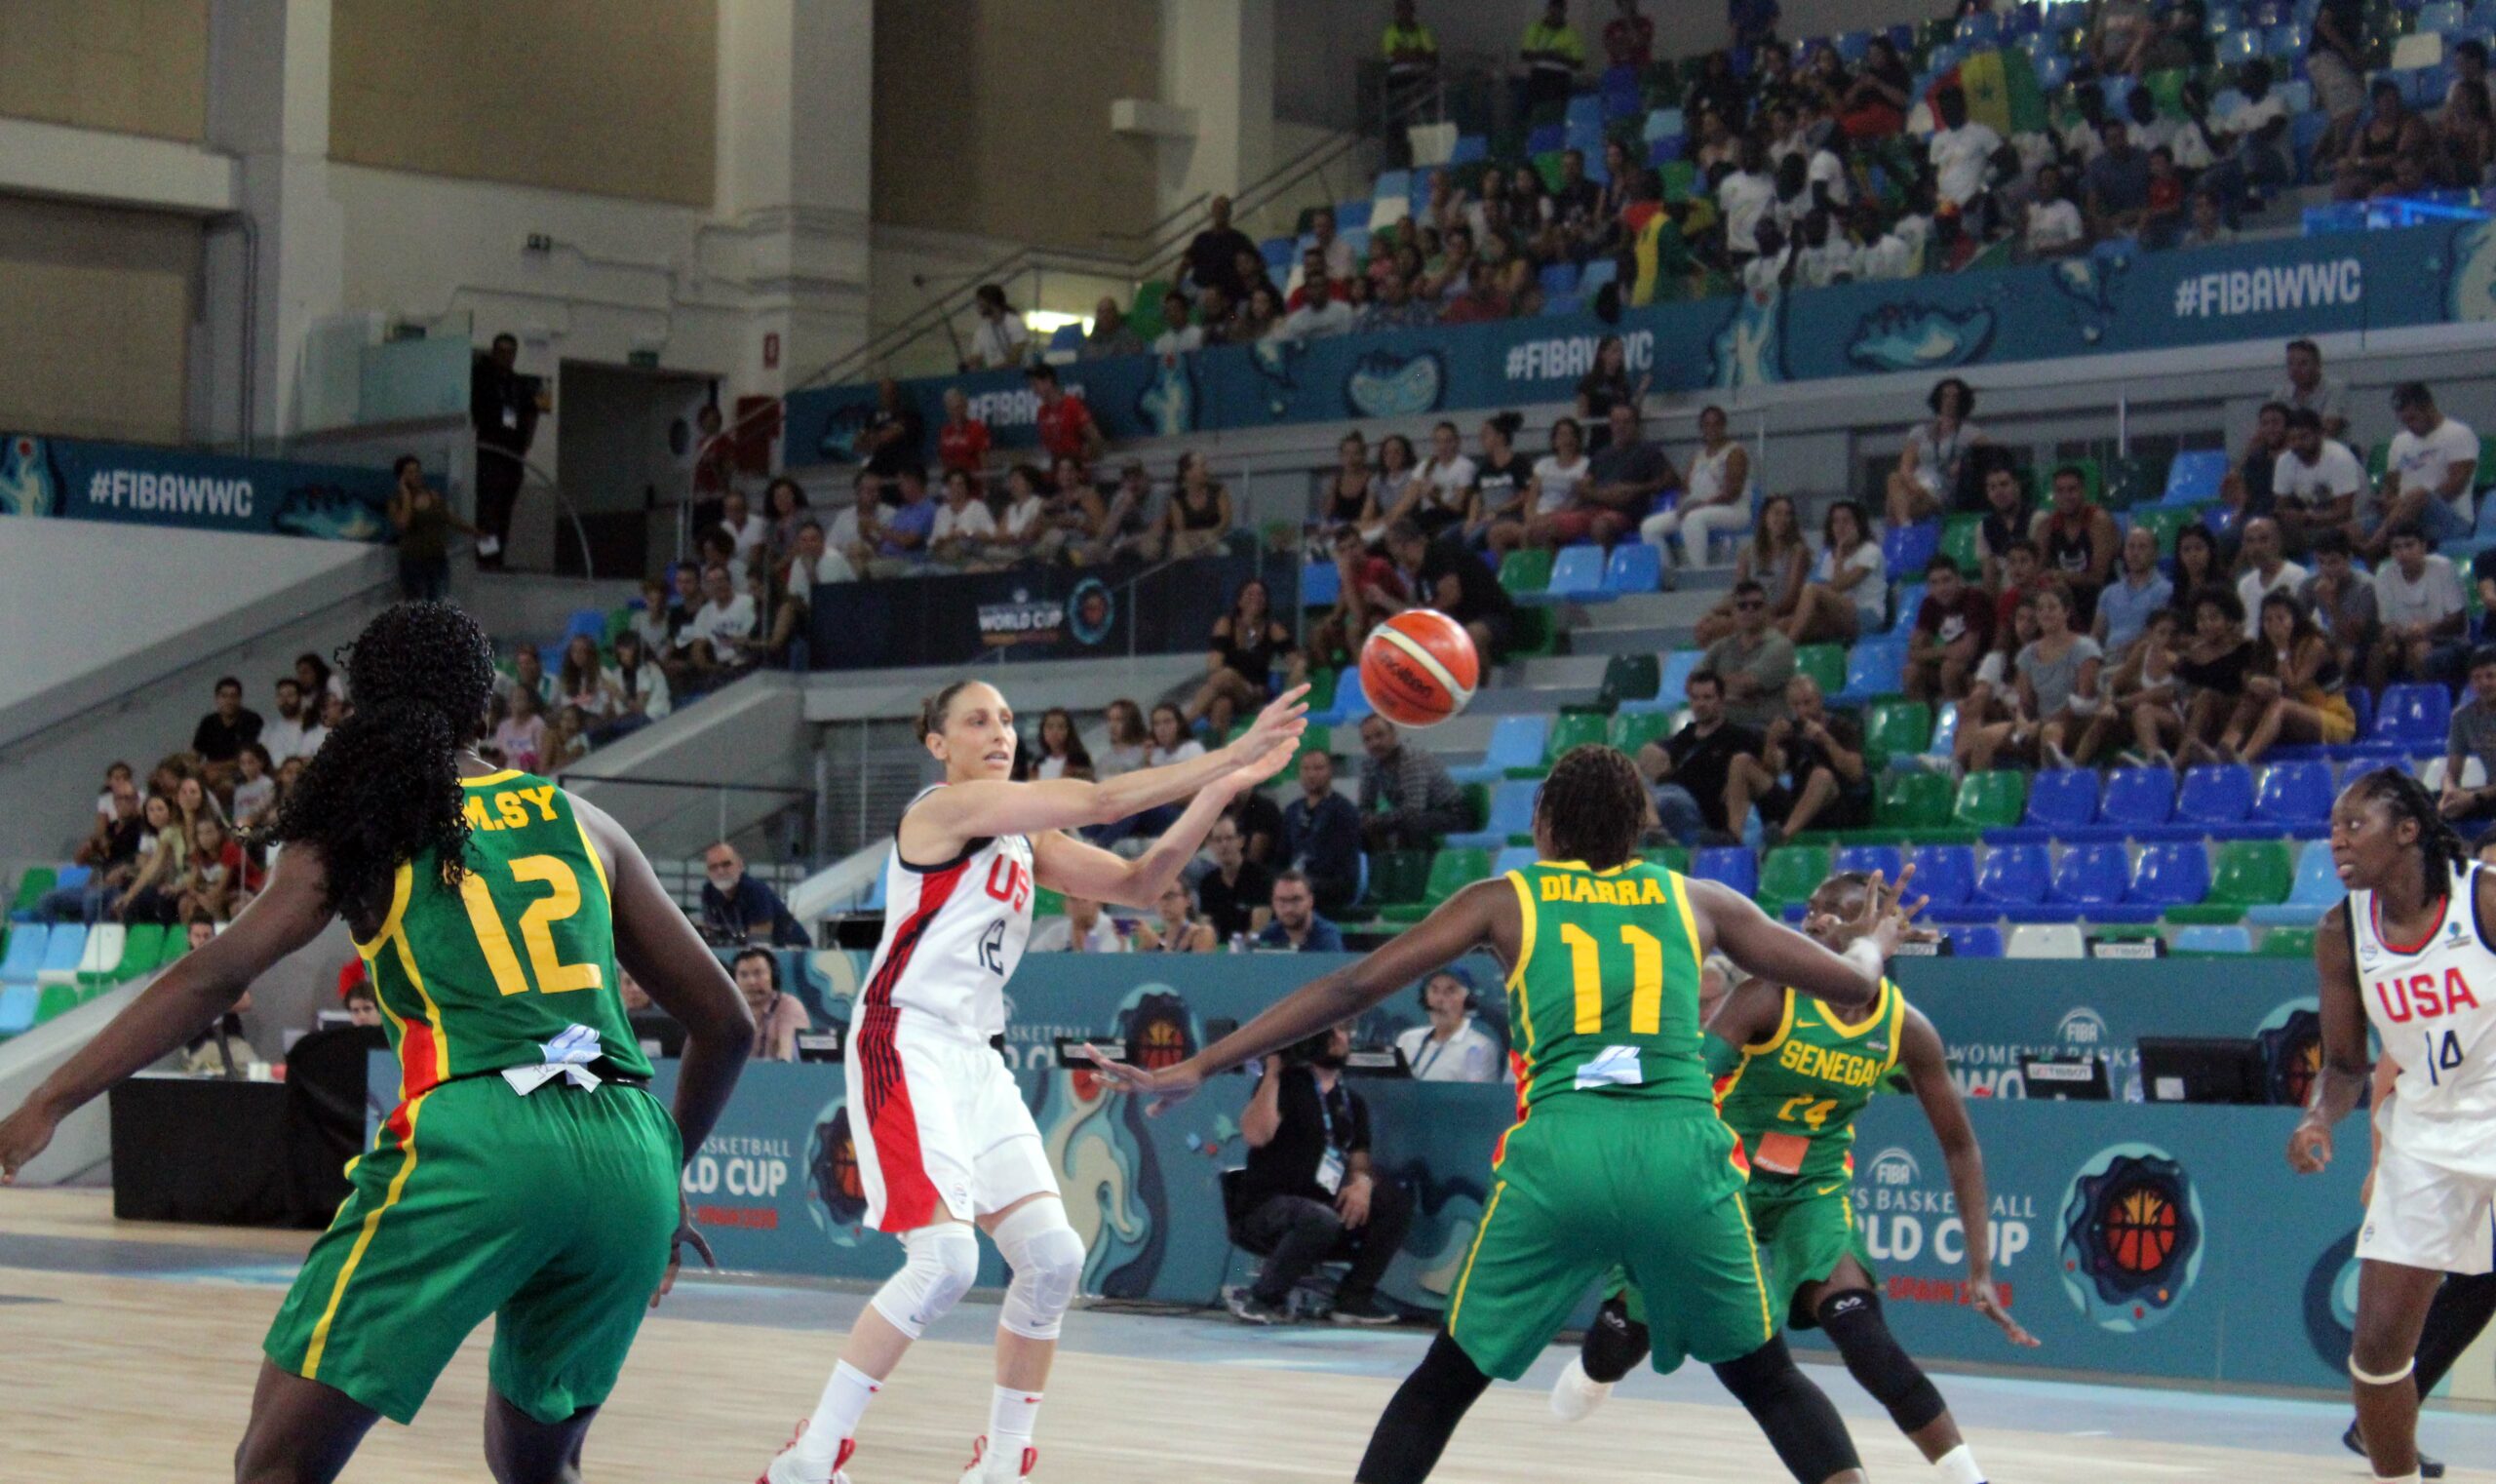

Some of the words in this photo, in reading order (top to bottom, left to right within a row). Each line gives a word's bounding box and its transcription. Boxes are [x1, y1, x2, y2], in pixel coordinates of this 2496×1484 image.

[2174, 257, 2361, 318] #FIBAWWC
[90, 469, 254, 518] #FIBAWWC
[985, 853, 1030, 914] US
[1540, 874, 1667, 906] DIARRA
[444, 853, 604, 997] 12
[1560, 922, 1663, 1035] 11
[2375, 966, 2480, 1023] USA
[2066, 1024, 2097, 1042] FIBA
[700, 1137, 792, 1158] ASKETBALL
[725, 1157, 788, 1197] CUP
[1876, 1163, 1911, 1186] FIBA
[1877, 1189, 2038, 1219] BASKEALL
